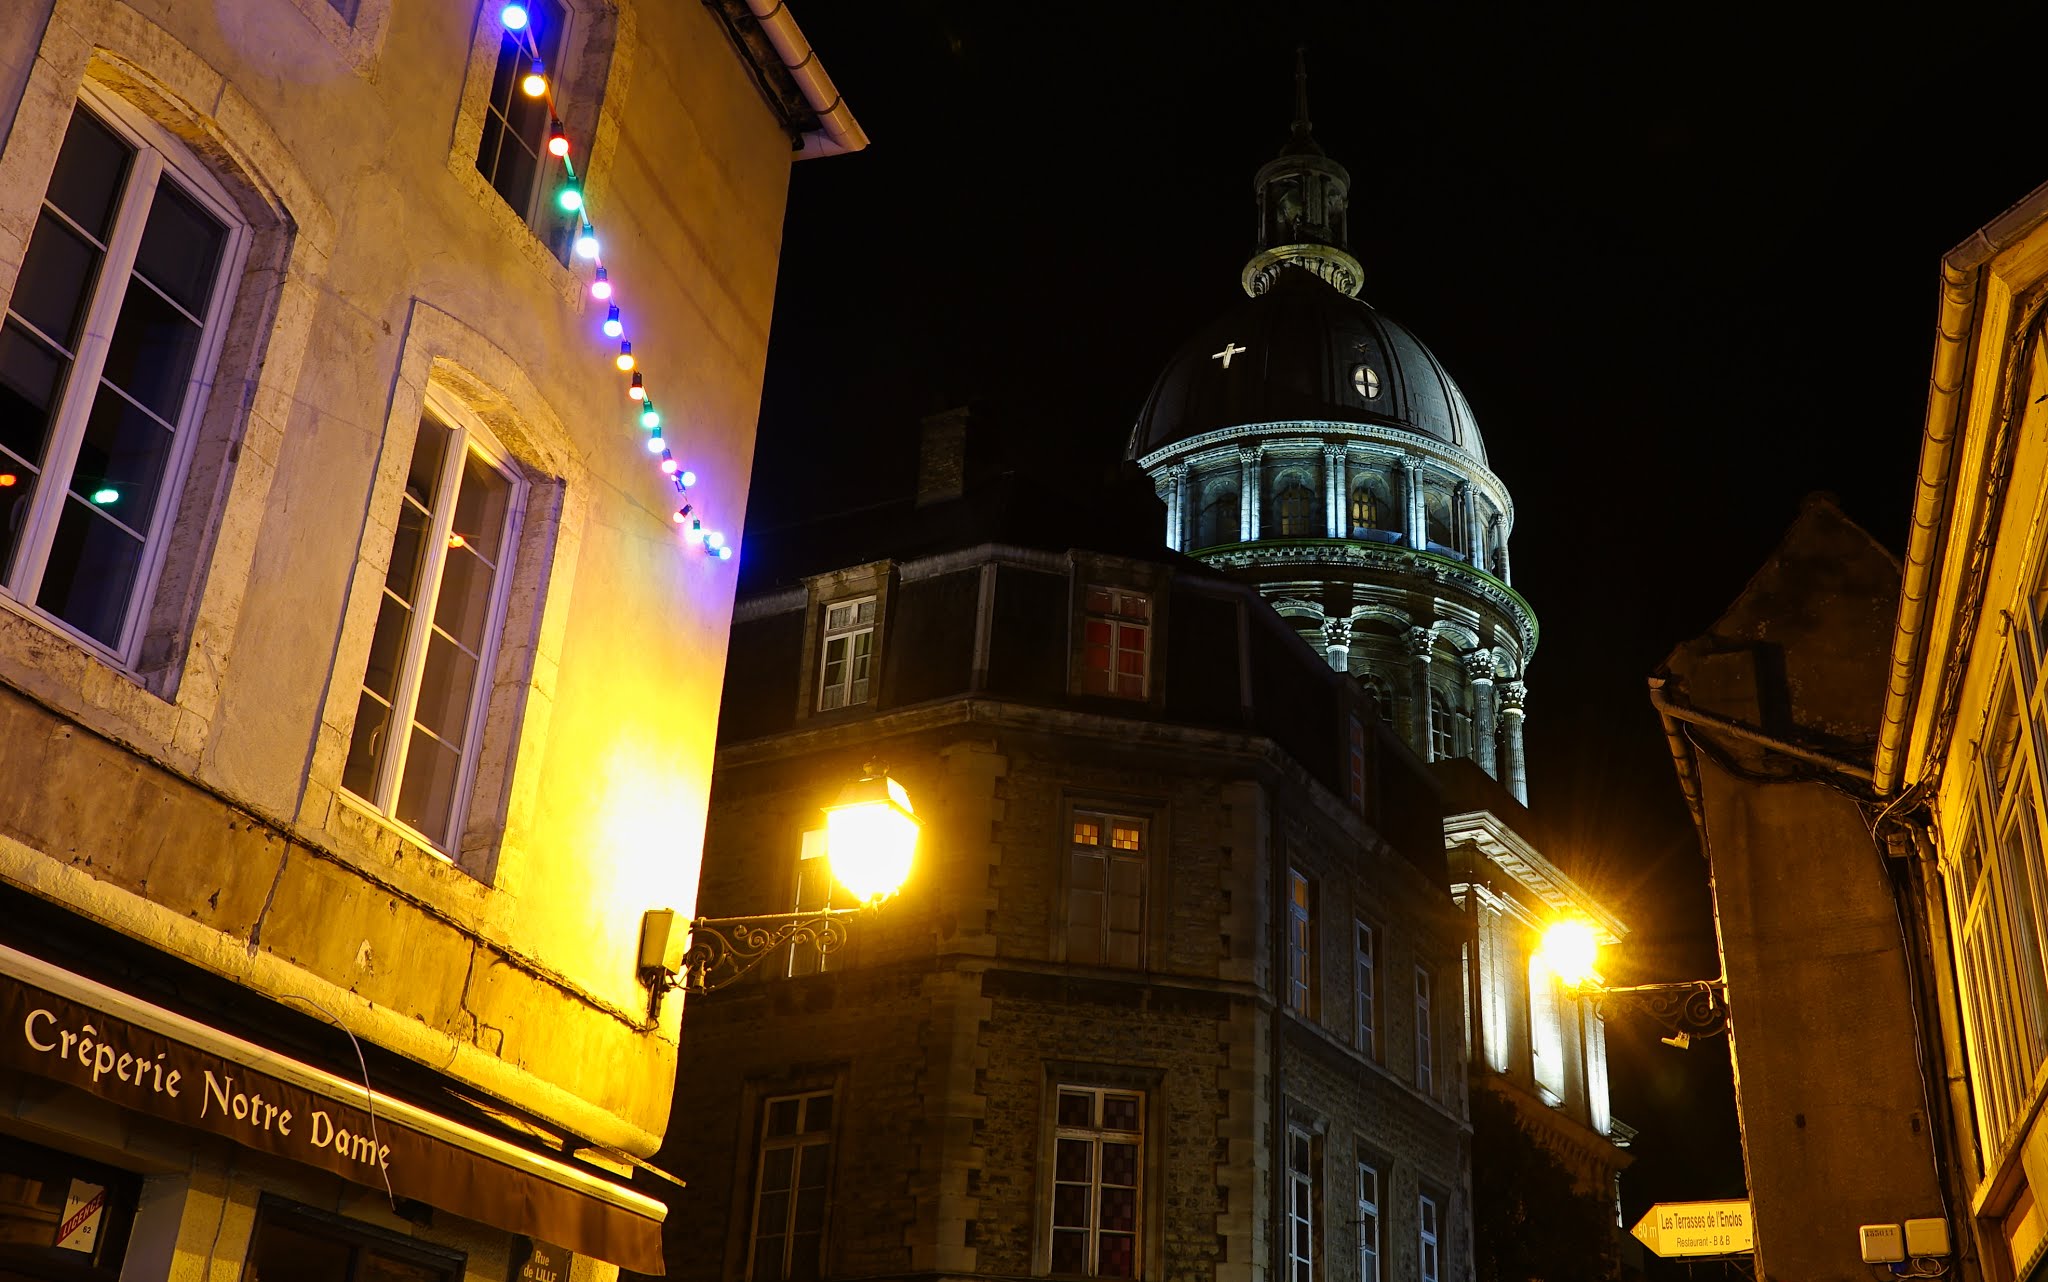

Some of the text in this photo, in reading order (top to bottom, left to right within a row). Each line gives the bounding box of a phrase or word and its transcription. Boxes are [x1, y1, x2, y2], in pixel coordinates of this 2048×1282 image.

[24, 1008, 391, 1171] Crêperie Notre Dame
[62, 1194, 103, 1238] LICENCE
[1661, 1210, 1743, 1230] Les Terrasses de l'Enclos
[1638, 1222, 1657, 1239] 50 m
[1676, 1237, 1709, 1247] Restaurant
[1713, 1235, 1718, 1246] B
[1719, 1235, 1724, 1246] &
[1725, 1235, 1730, 1246] B
[535, 1250, 550, 1267] Rue
[523, 1264, 557, 1282] de LILLE
